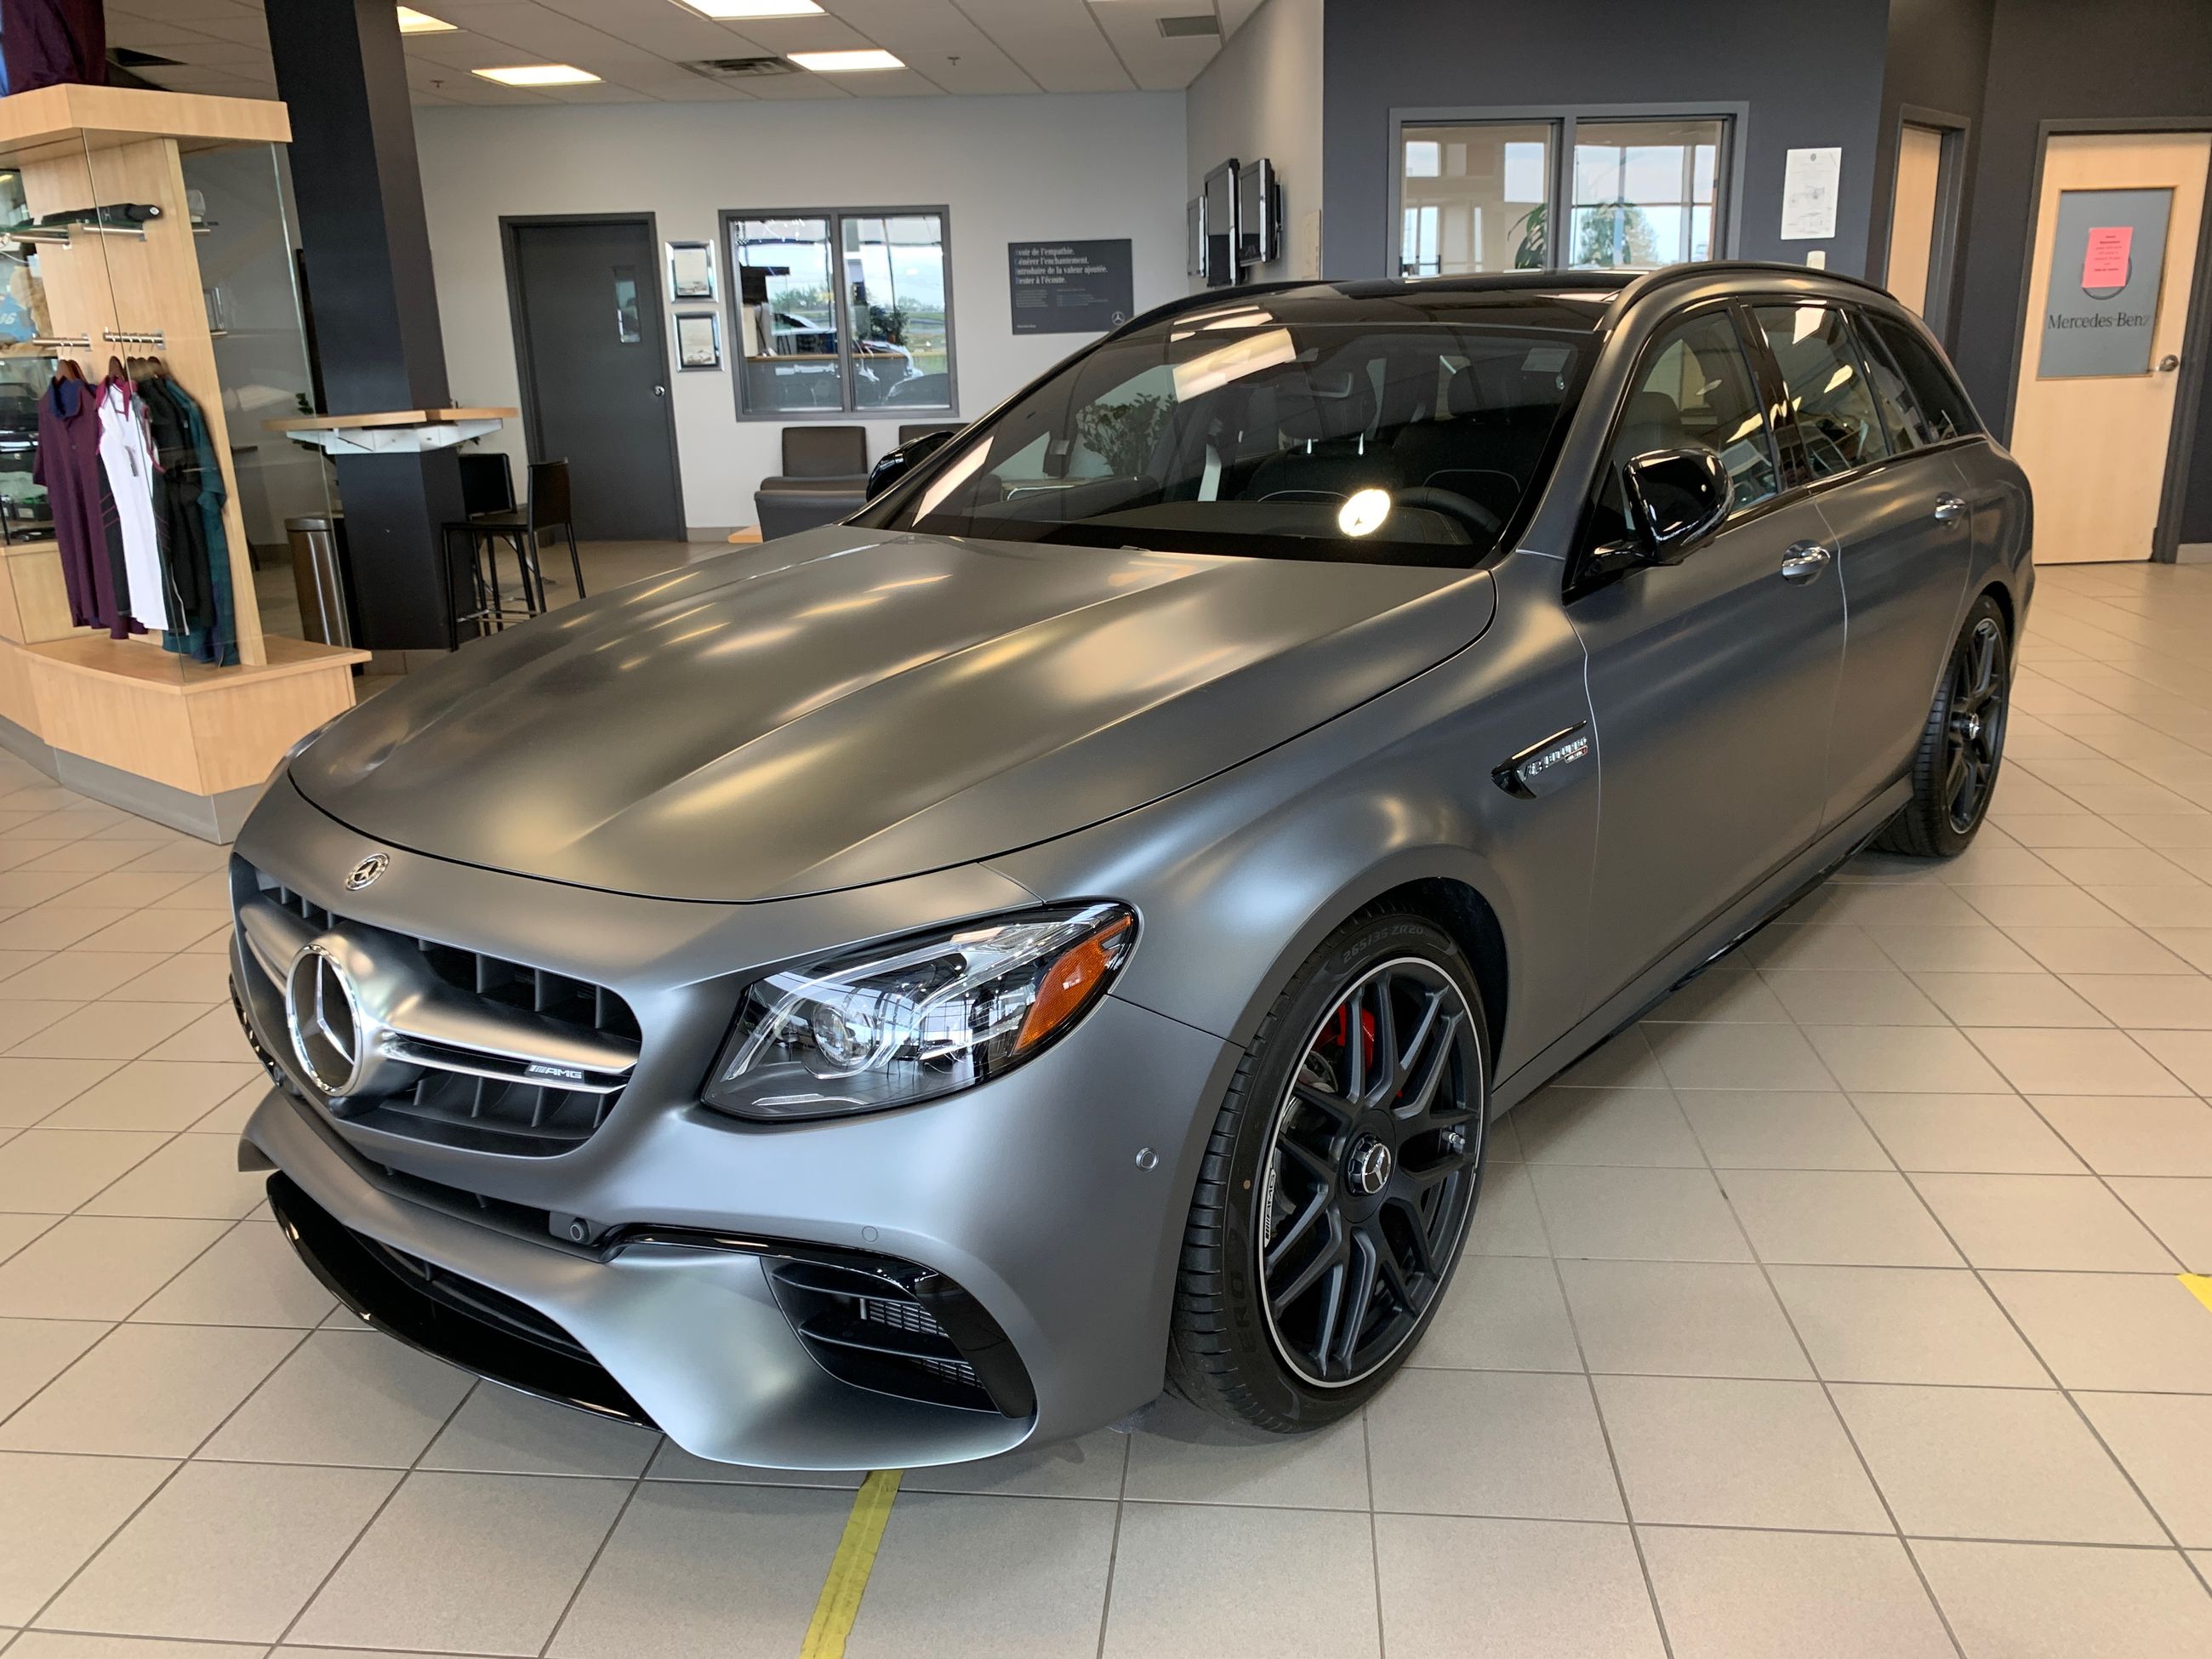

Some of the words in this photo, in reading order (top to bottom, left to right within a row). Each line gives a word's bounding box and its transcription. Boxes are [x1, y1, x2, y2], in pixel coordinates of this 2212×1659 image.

[1031, 248, 1039, 256] de
[1056, 265, 1063, 274] la
[2048, 311, 2151, 329] Mercedes-Benz
